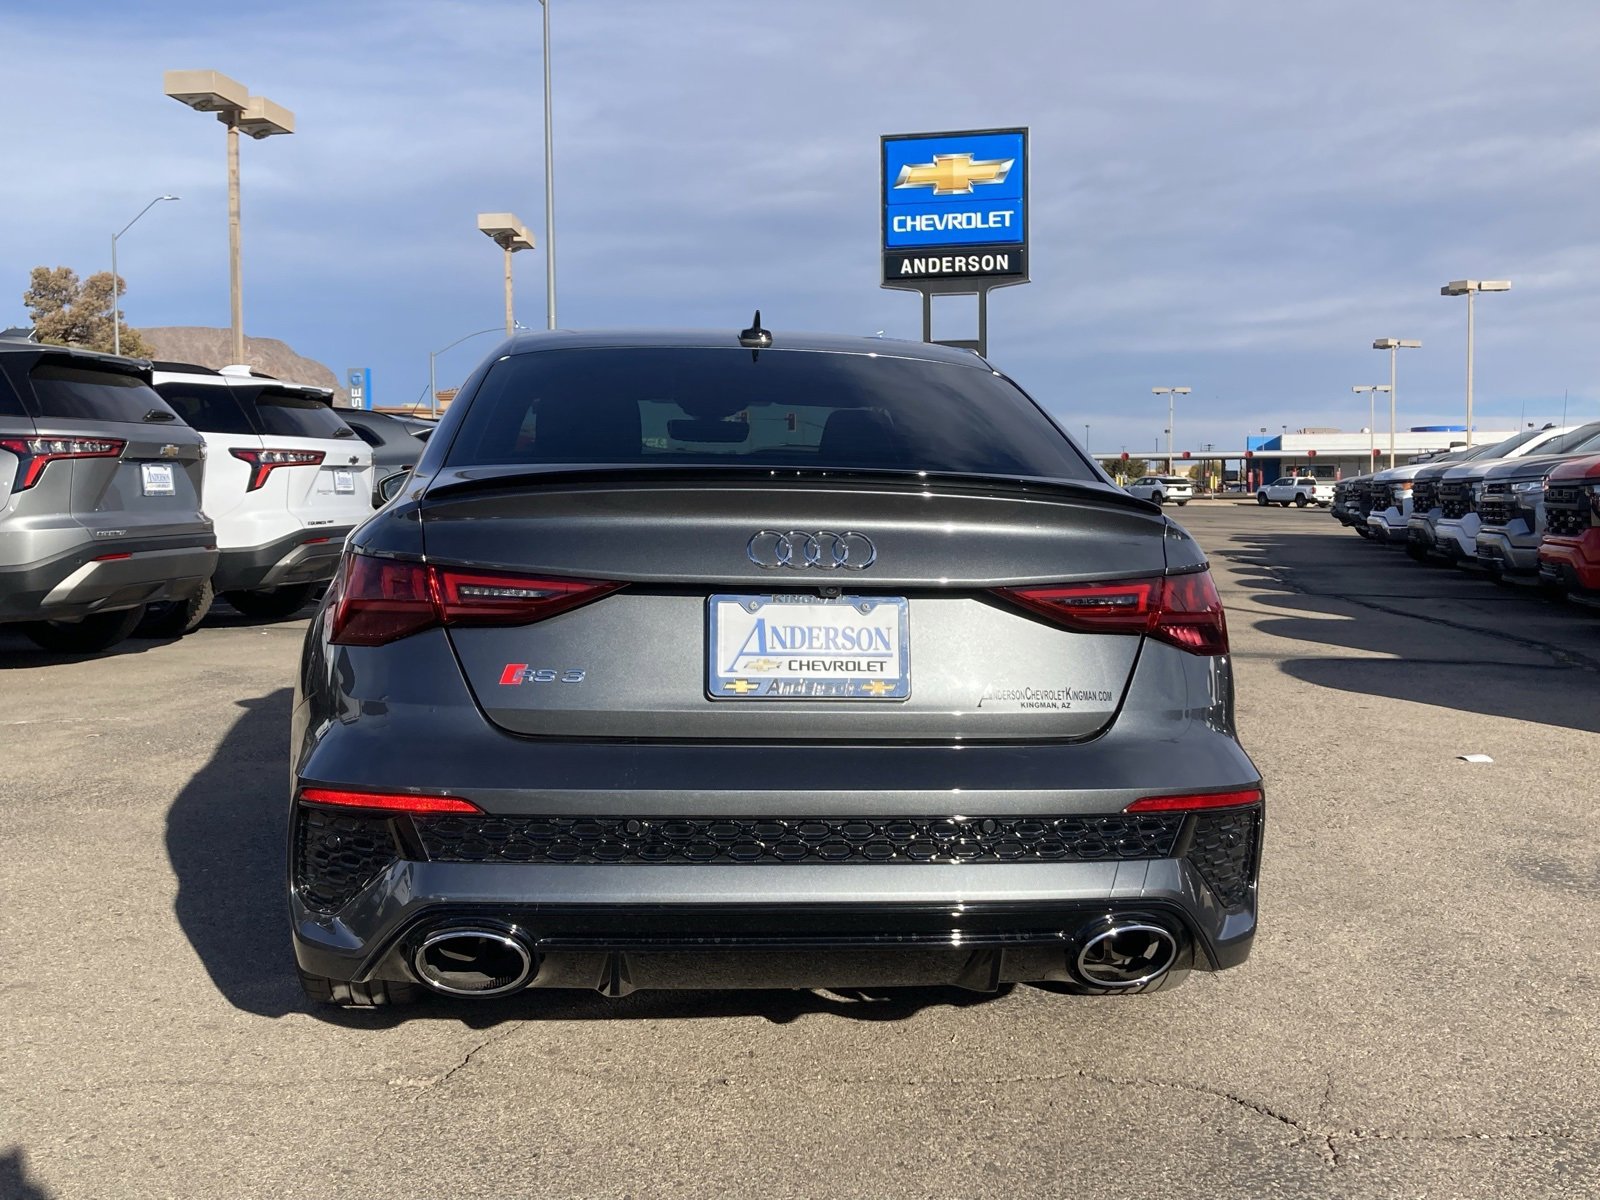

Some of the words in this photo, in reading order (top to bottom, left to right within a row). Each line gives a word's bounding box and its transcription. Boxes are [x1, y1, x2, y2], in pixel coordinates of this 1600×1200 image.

[893, 211, 1014, 232] CHEVROLET
[900, 254, 1009, 274] ANDERSON
[351, 388, 362, 410] SE
[724, 618, 892, 672] ANDERSON
[561, 668, 586, 683] 3
[788, 659, 887, 672] CHEVROLET
